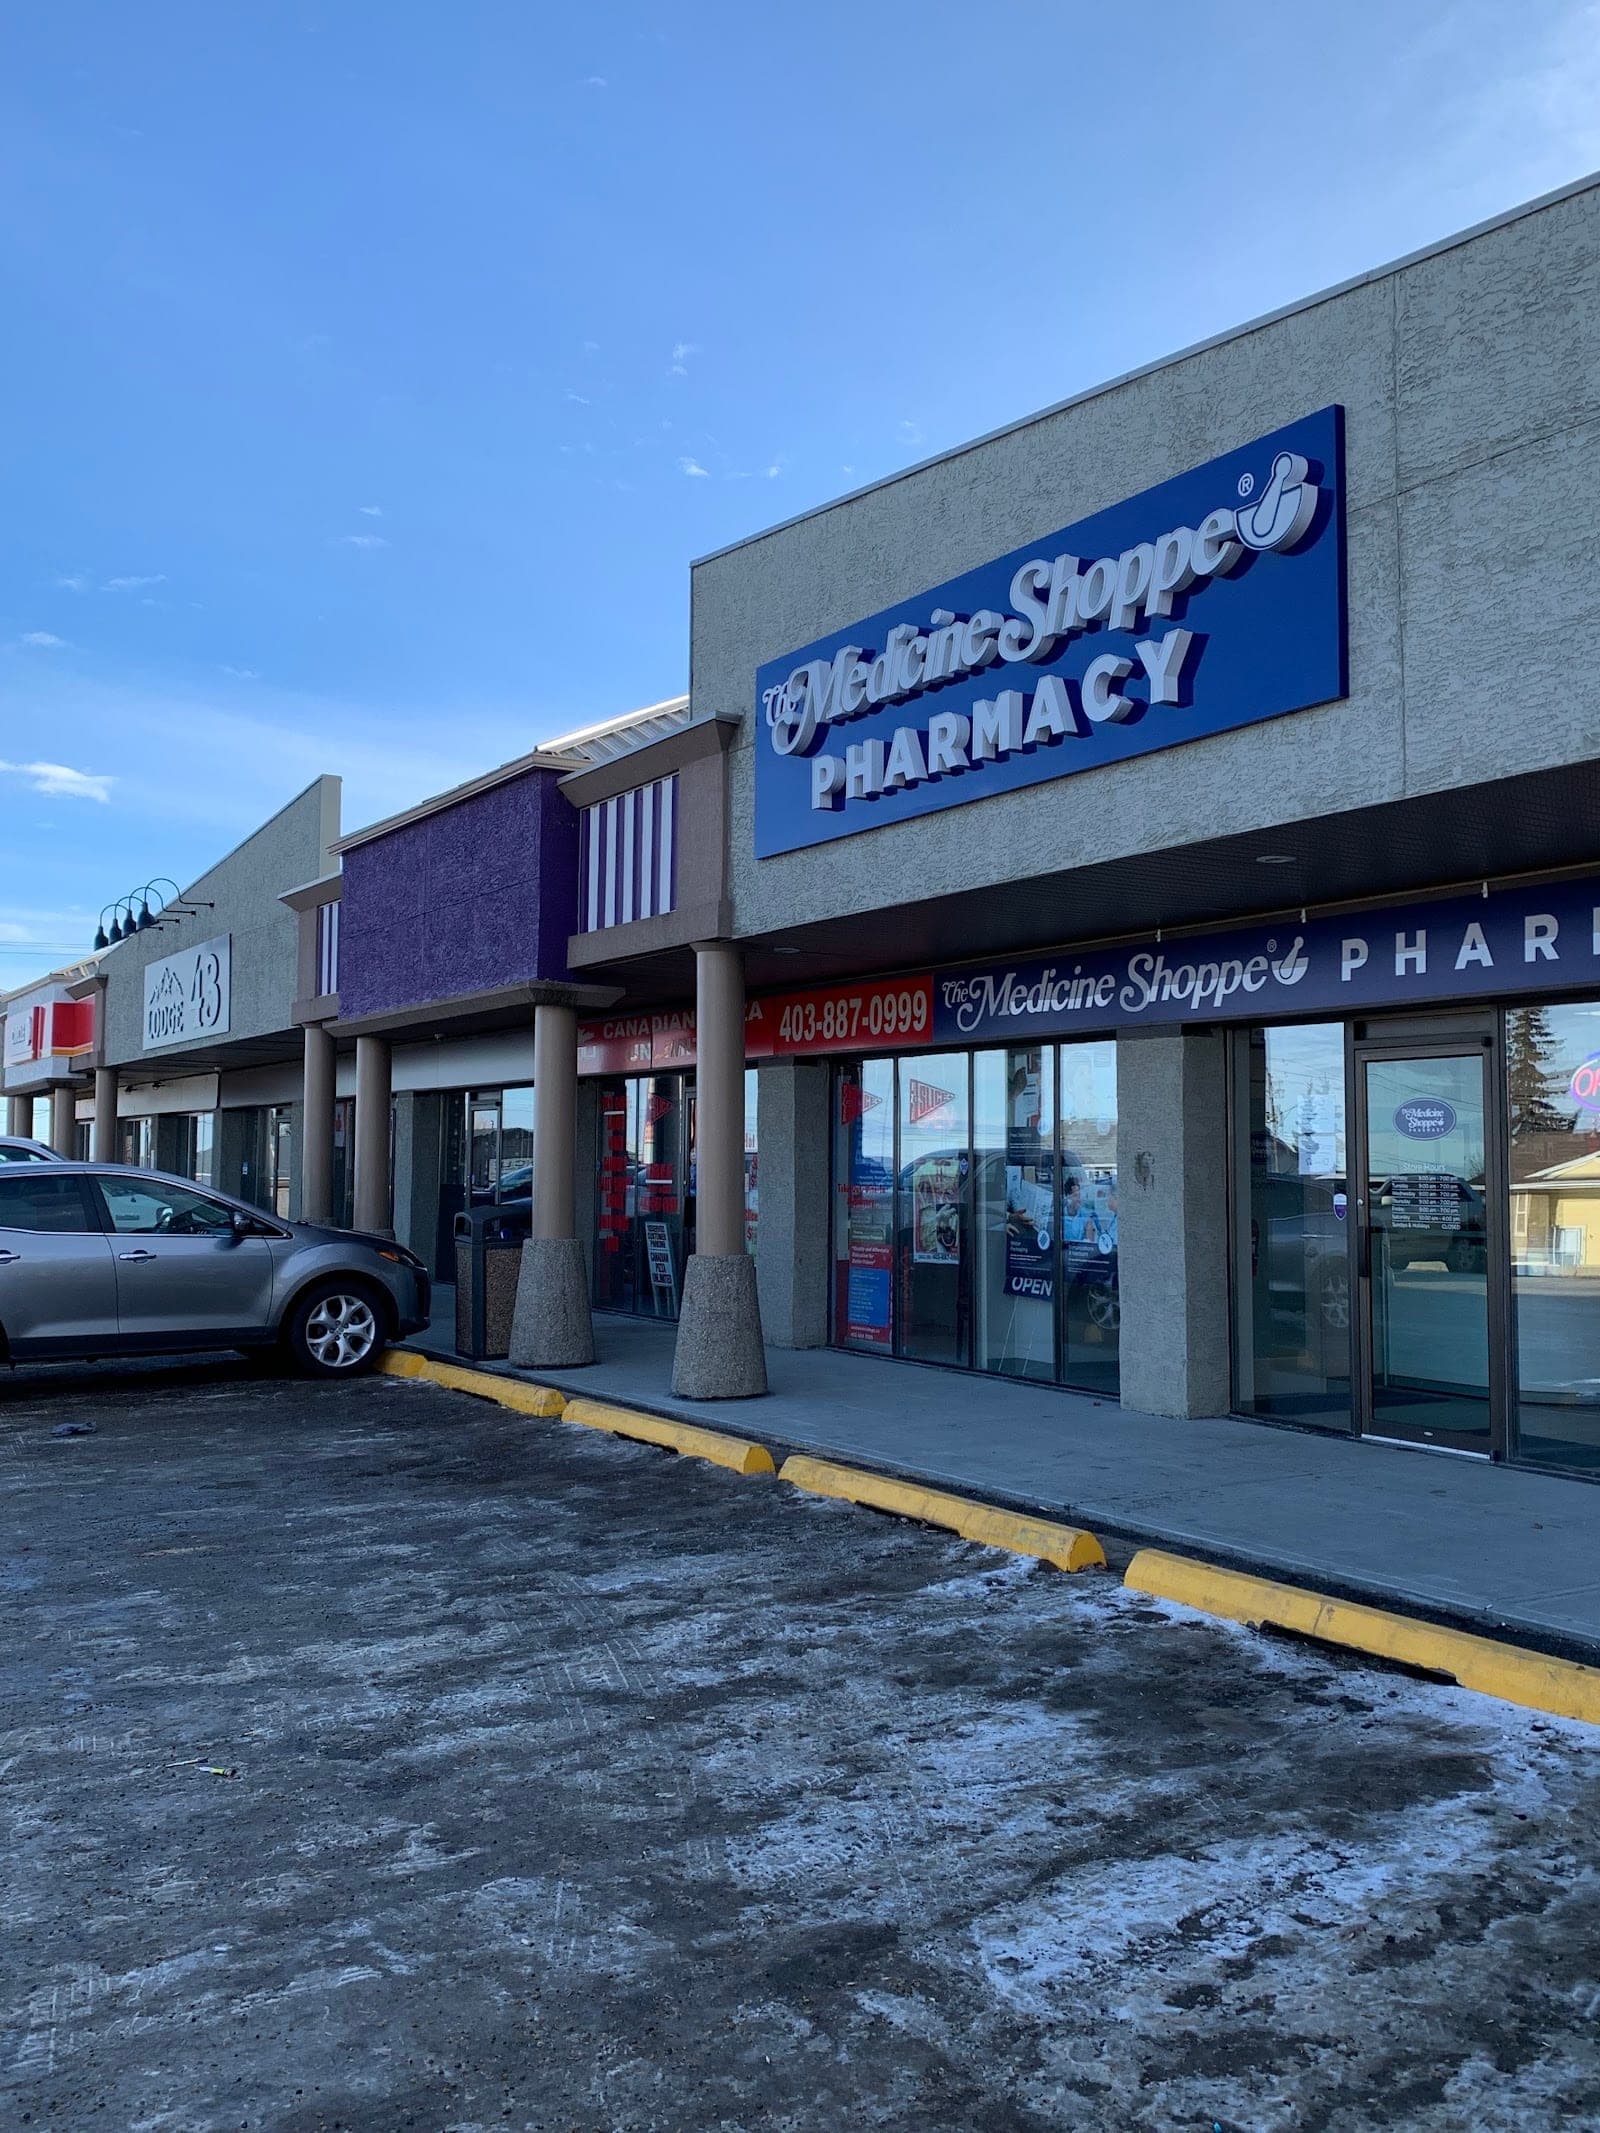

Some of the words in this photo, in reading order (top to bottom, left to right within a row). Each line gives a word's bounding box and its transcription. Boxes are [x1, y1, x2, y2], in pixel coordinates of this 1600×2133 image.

[772, 608, 1004, 755] Medicine
[998, 508, 1244, 662] Shoppe
[812, 628, 1193, 809] PHARMACY
[191, 953, 221, 1028] 43
[941, 979, 969, 1009] The
[957, 965, 1115, 1032] Medicine
[1119, 952, 1268, 1012] Shoppe
[1341, 907, 1600, 982] PHAR
[147, 1001, 184, 1039] LODGE
[603, 1010, 695, 1040] CANADIAN
[779, 989, 928, 1042] 403-887-0999
[1011, 1276, 1053, 1297] OPEN
